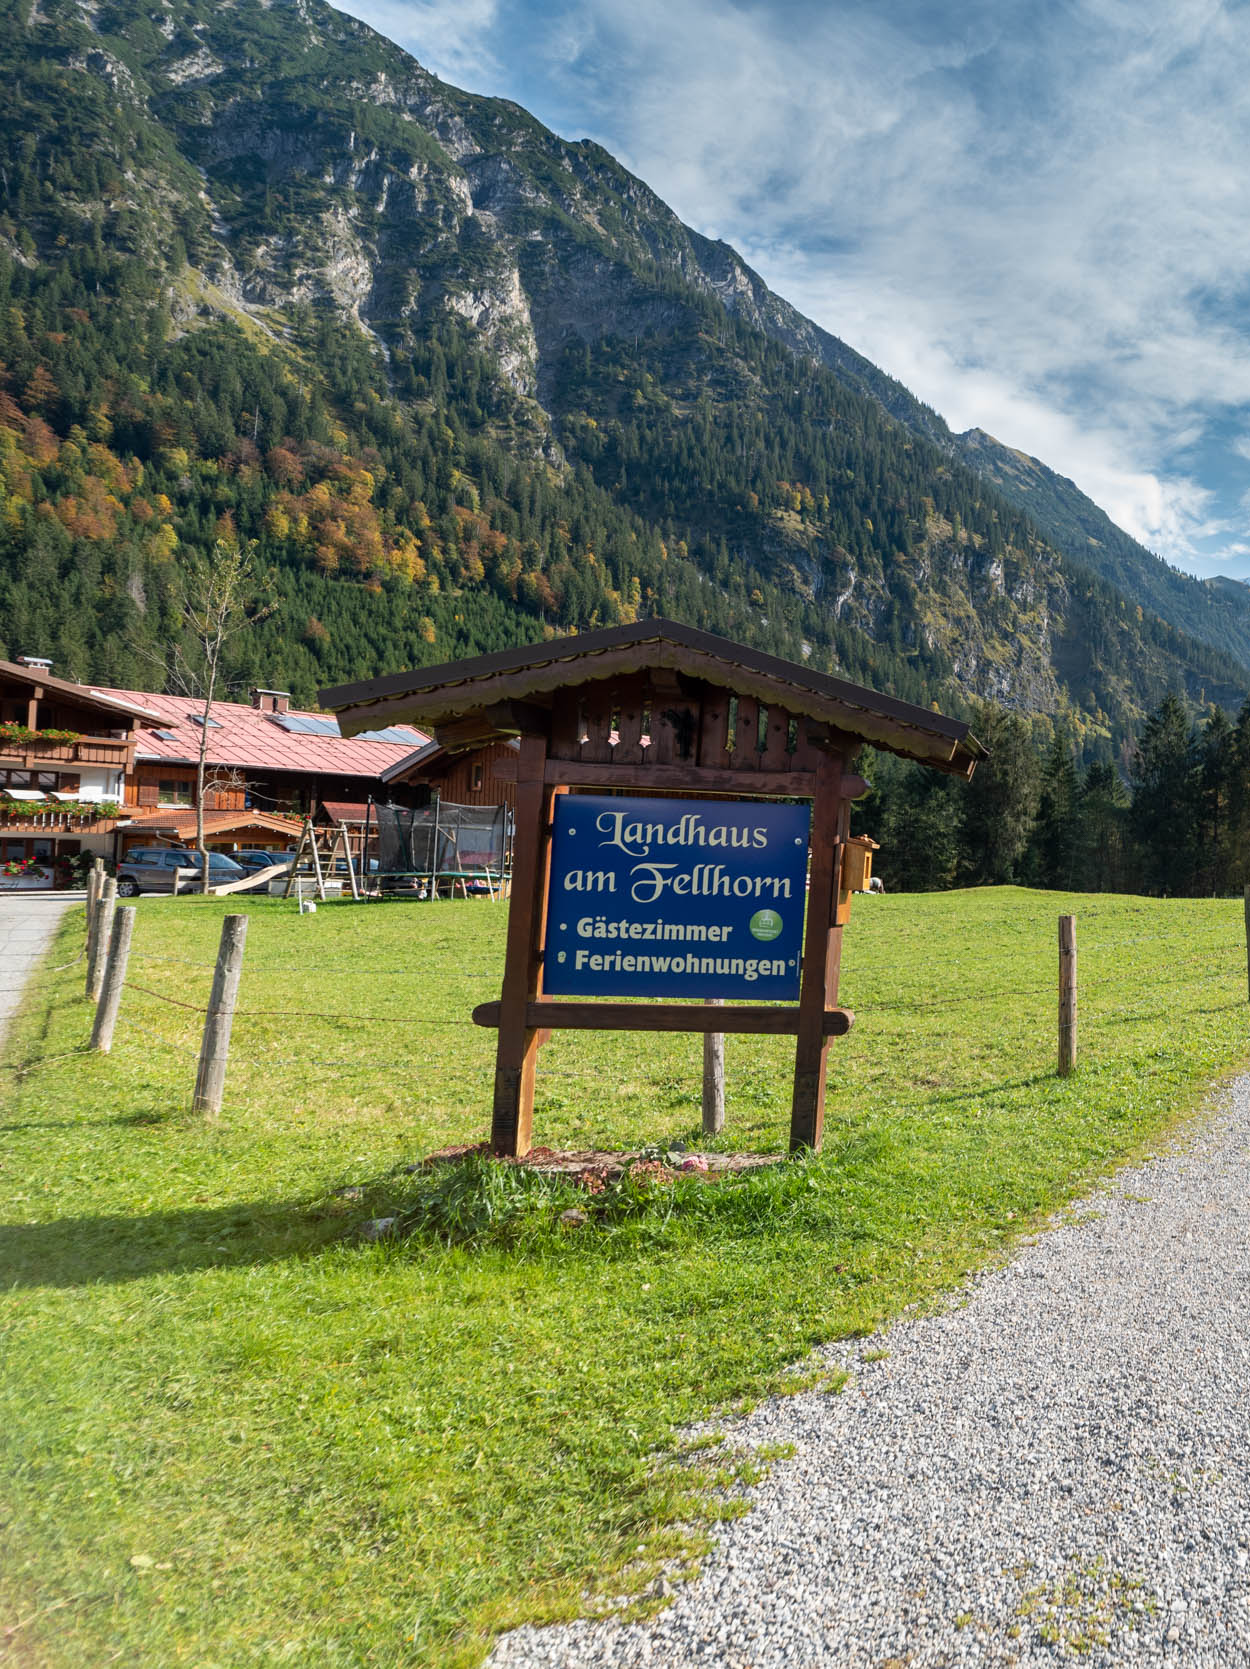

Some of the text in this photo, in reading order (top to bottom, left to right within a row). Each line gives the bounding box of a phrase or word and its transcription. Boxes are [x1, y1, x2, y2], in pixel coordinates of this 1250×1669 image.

[596, 811, 768, 857] Landhaus
[564, 863, 792, 903] am Fellhorn
[576, 916, 733, 942] Gästezimmer
[575, 949, 786, 981] Ferienwohnungen
